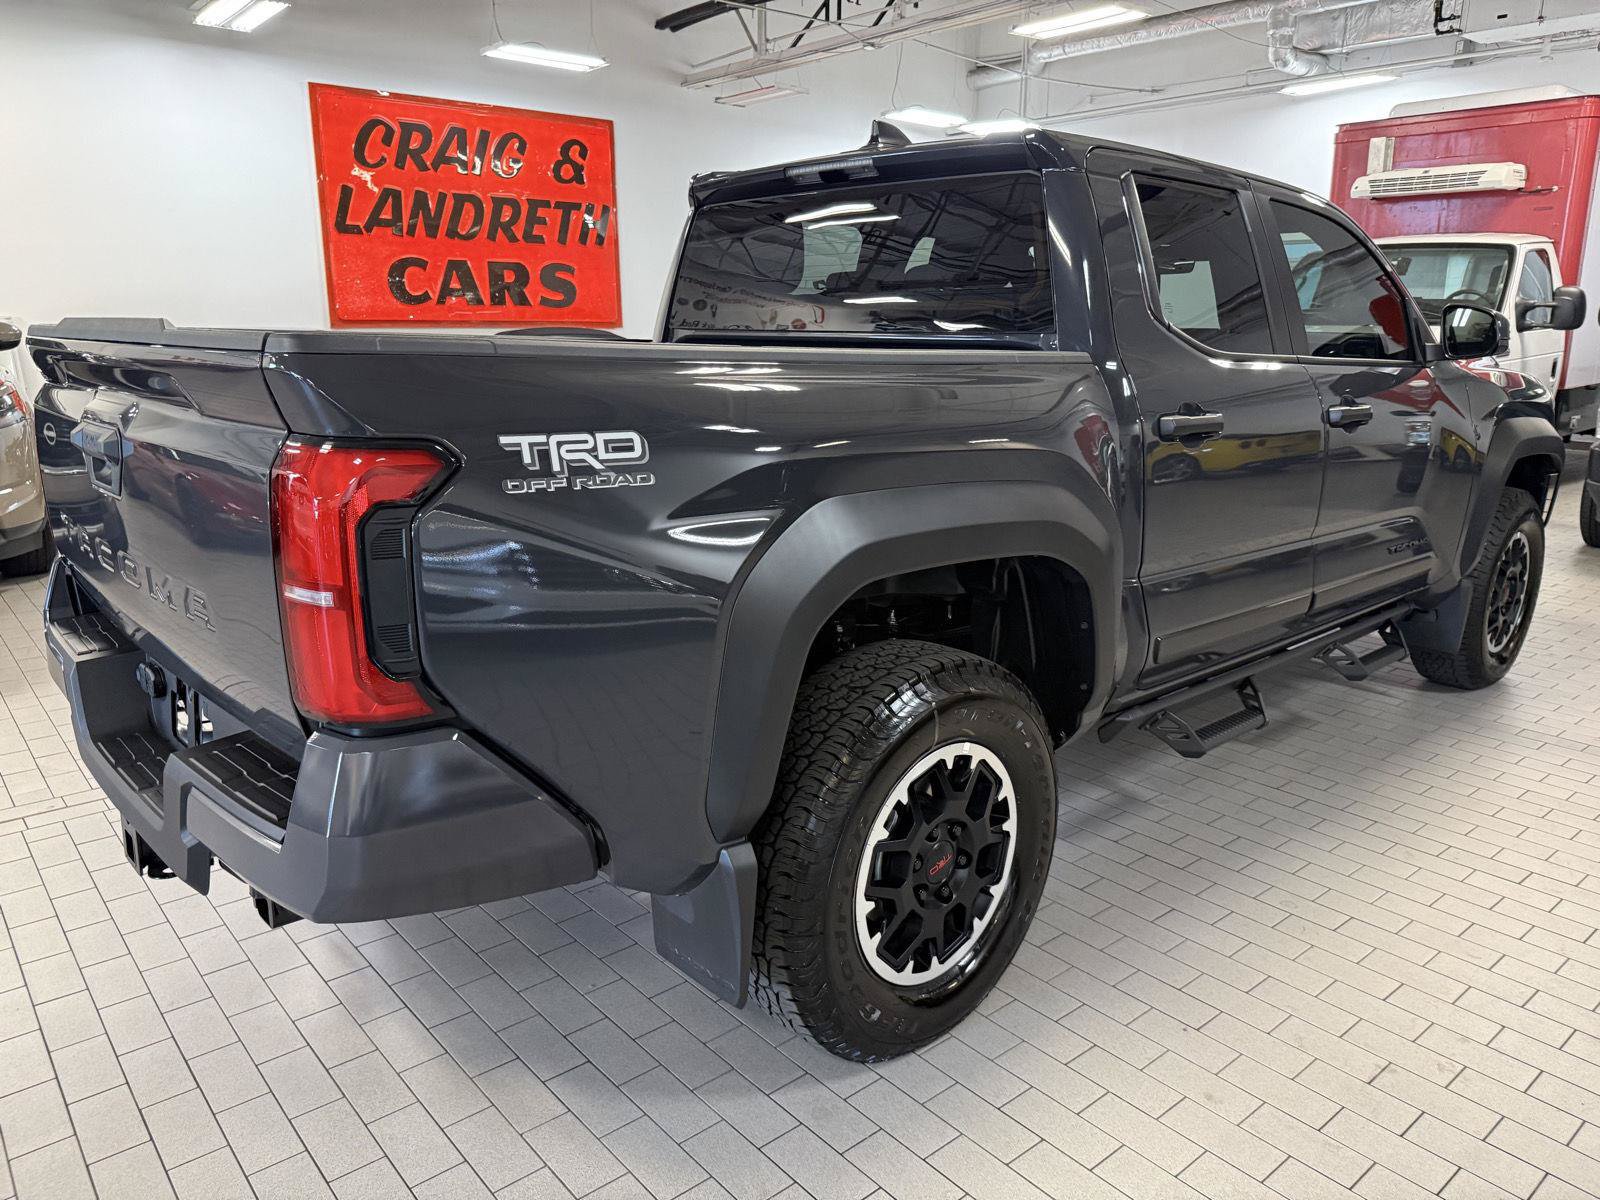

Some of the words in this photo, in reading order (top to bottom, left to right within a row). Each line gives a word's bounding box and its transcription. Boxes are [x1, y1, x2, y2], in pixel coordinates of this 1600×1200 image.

[353, 116, 528, 179] CRAIG
[551, 138, 590, 186] &
[334, 184, 611, 247] LANDRETH
[387, 256, 578, 309] CARS
[498, 430, 650, 477] TRD
[502, 476, 568, 494] OFF
[571, 471, 656, 491] ROAD
[59, 510, 217, 634] TACOMA
[928, 852, 954, 876] TRD
